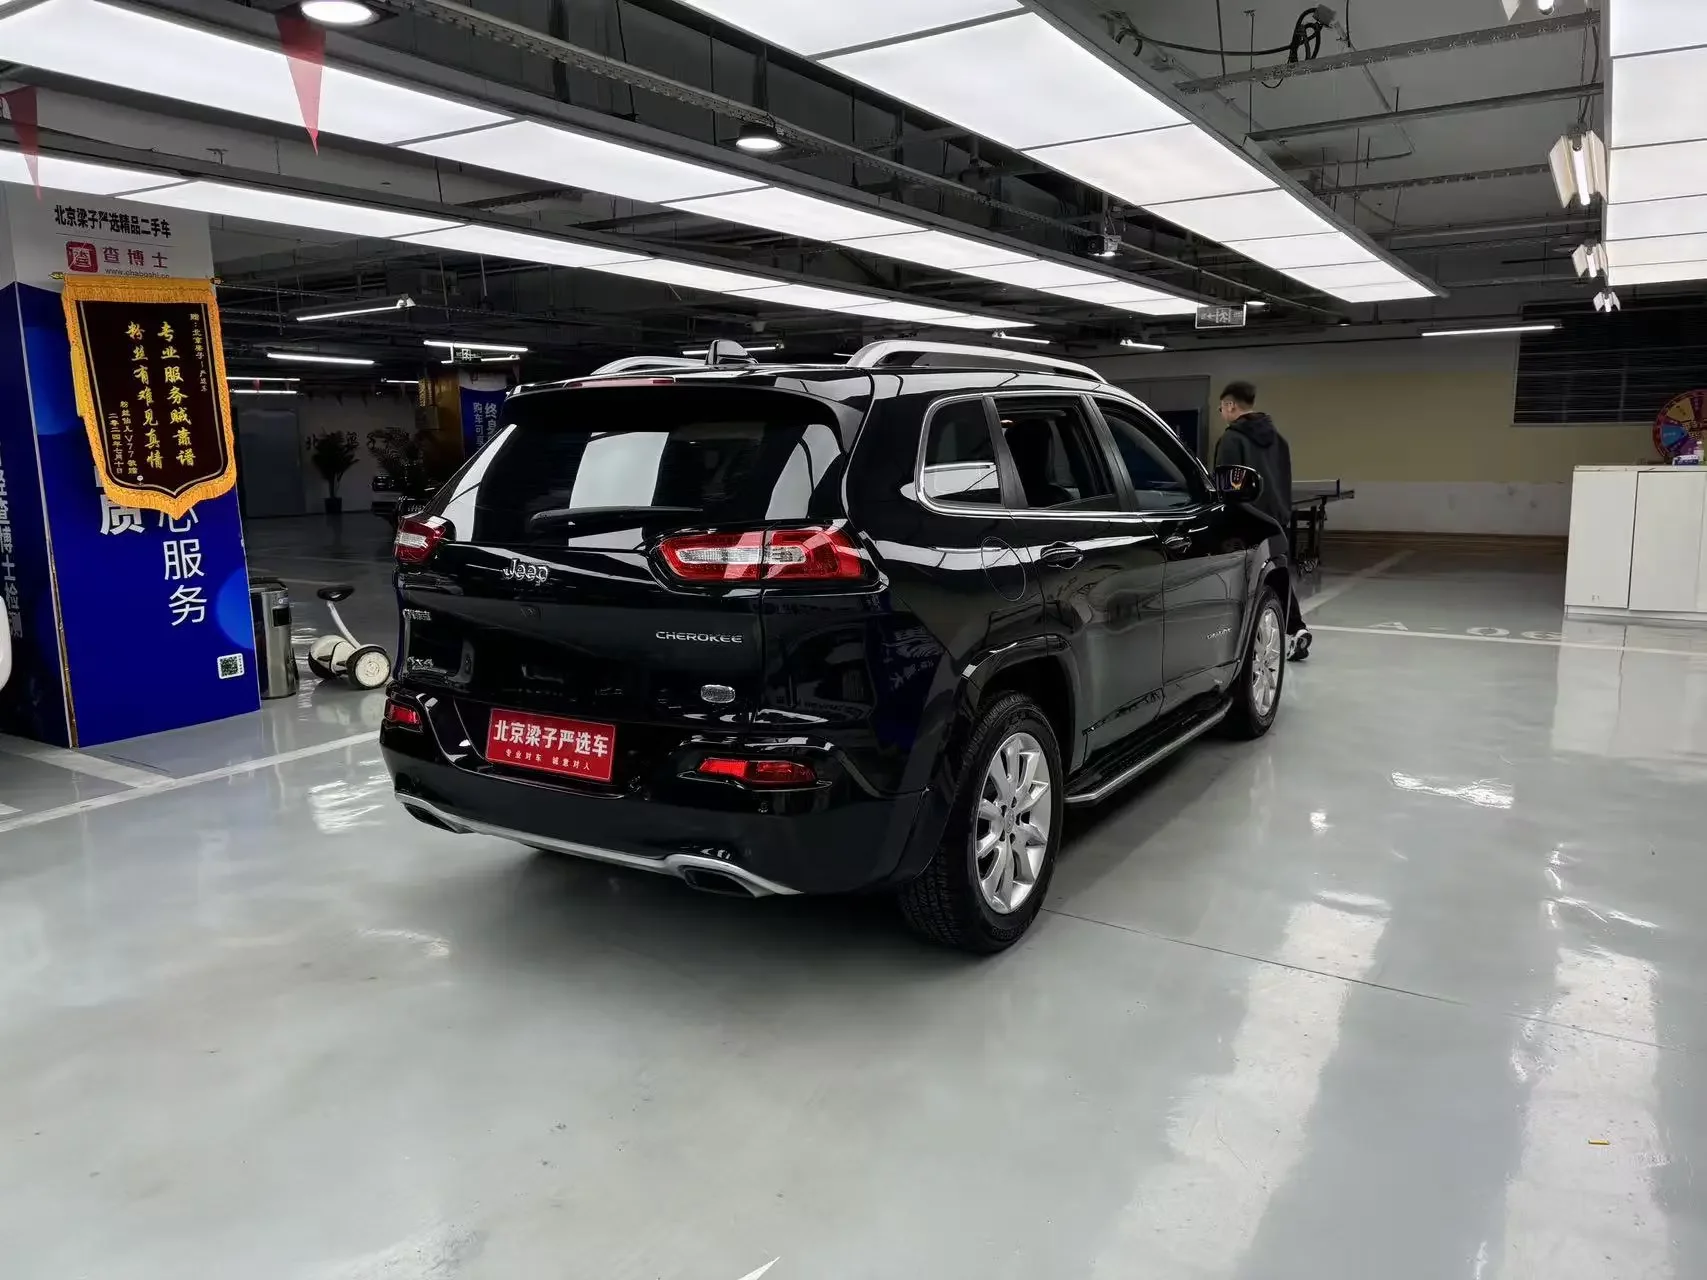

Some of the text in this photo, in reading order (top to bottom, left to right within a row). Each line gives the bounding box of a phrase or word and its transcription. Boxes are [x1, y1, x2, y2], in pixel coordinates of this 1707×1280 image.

[54, 204, 171, 238] 北京梁子严选精品二手车
[102, 246, 168, 269] 查博士
[126, 321, 164, 469] 粉丝有难见真情
[157, 321, 196, 467] 专业服务贼靠谱
[484, 402, 498, 440] 终身
[503, 559, 549, 586] Jeep
[655, 631, 743, 643] CHEROKEE
[493, 719, 609, 757] 北京梁子严选车
